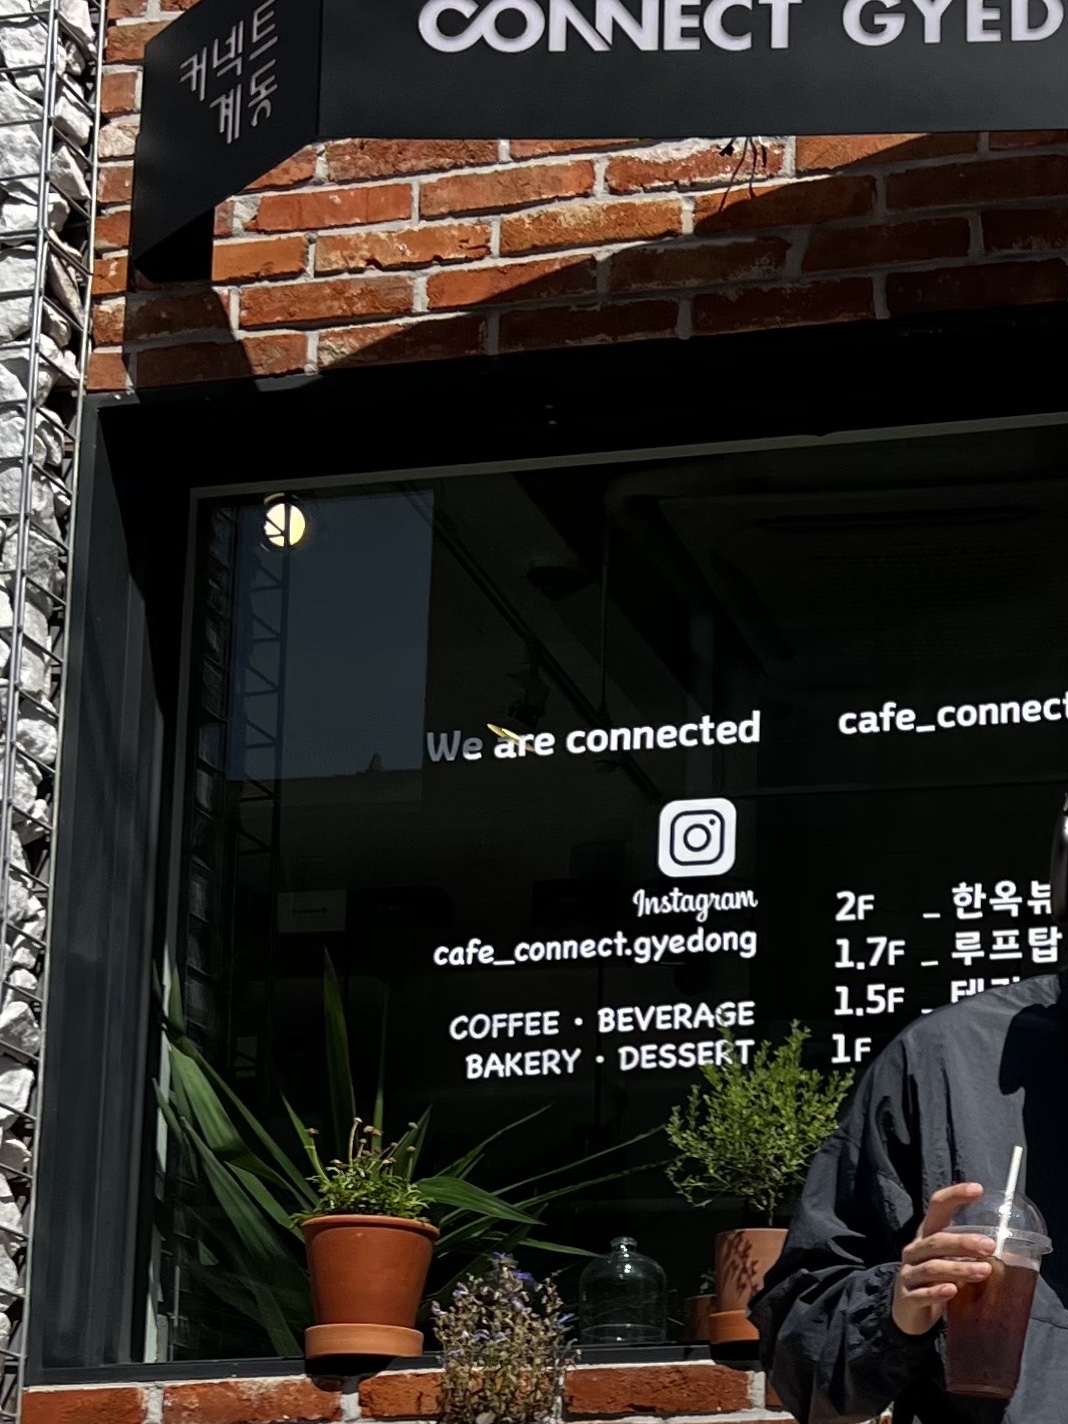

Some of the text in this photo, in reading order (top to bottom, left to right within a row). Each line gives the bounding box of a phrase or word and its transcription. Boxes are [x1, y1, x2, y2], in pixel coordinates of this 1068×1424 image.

[418, 0, 802, 53] CONNECT
[179, 0, 279, 101] 커넥트
[208, 59, 278, 144] 계동
[426, 709, 761, 762] We are connected
[632, 887, 759, 922] Instagram
[835, 890, 875, 921] 2F
[433, 926, 757, 965] cafe_connect.gyedong
[834, 936, 906, 970] 1.7F
[951, 926, 1063, 966] 루프탑
[449, 1010, 561, 1041] COFFEE
[597, 1000, 756, 1034] BEVERAGE
[834, 983, 905, 1017] 1.5F
[465, 1047, 582, 1080] BAKERY
[617, 1038, 756, 1071] DESSERT
[831, 1033, 872, 1064] 1F
